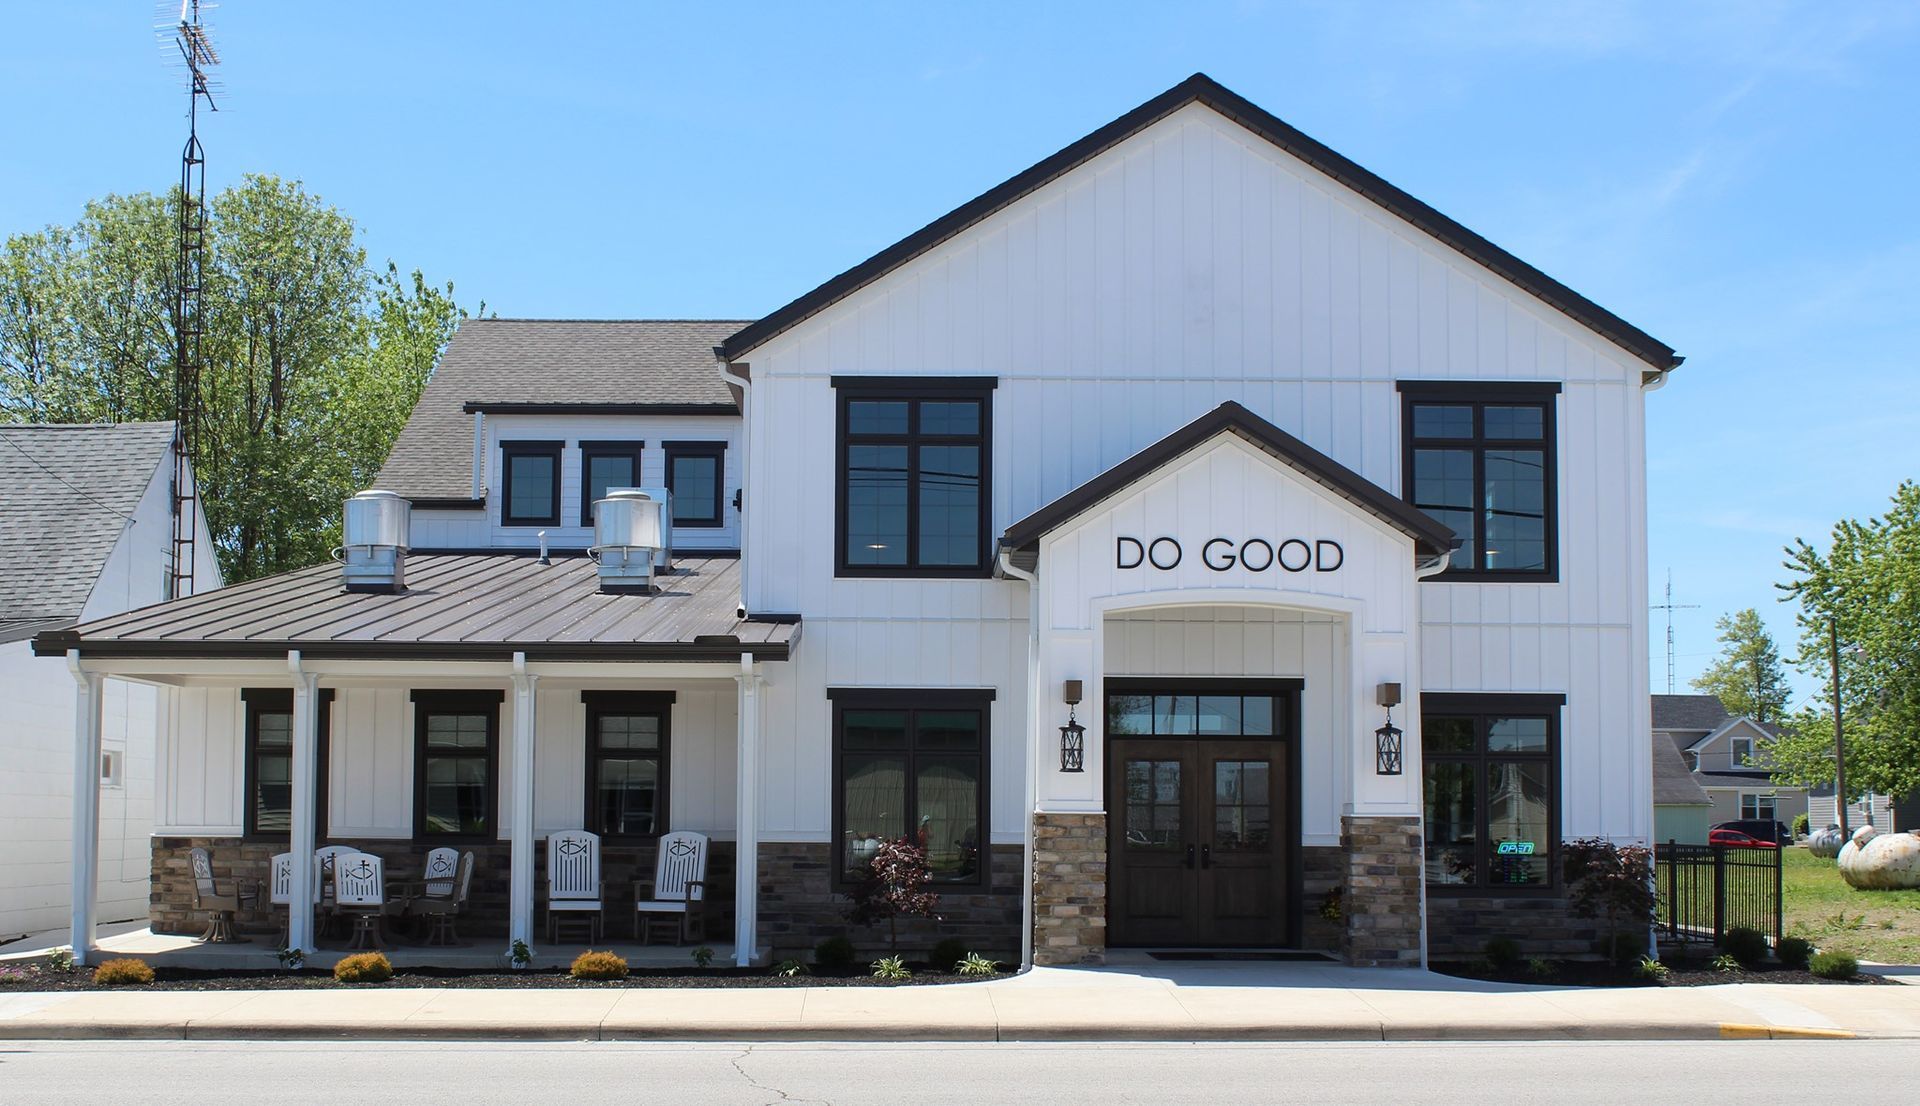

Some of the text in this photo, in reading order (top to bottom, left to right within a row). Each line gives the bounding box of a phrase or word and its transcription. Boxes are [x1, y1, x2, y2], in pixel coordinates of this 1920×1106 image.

[1116, 536, 1344, 573] DO GOOD
[1500, 844, 1533, 853] OPEN
